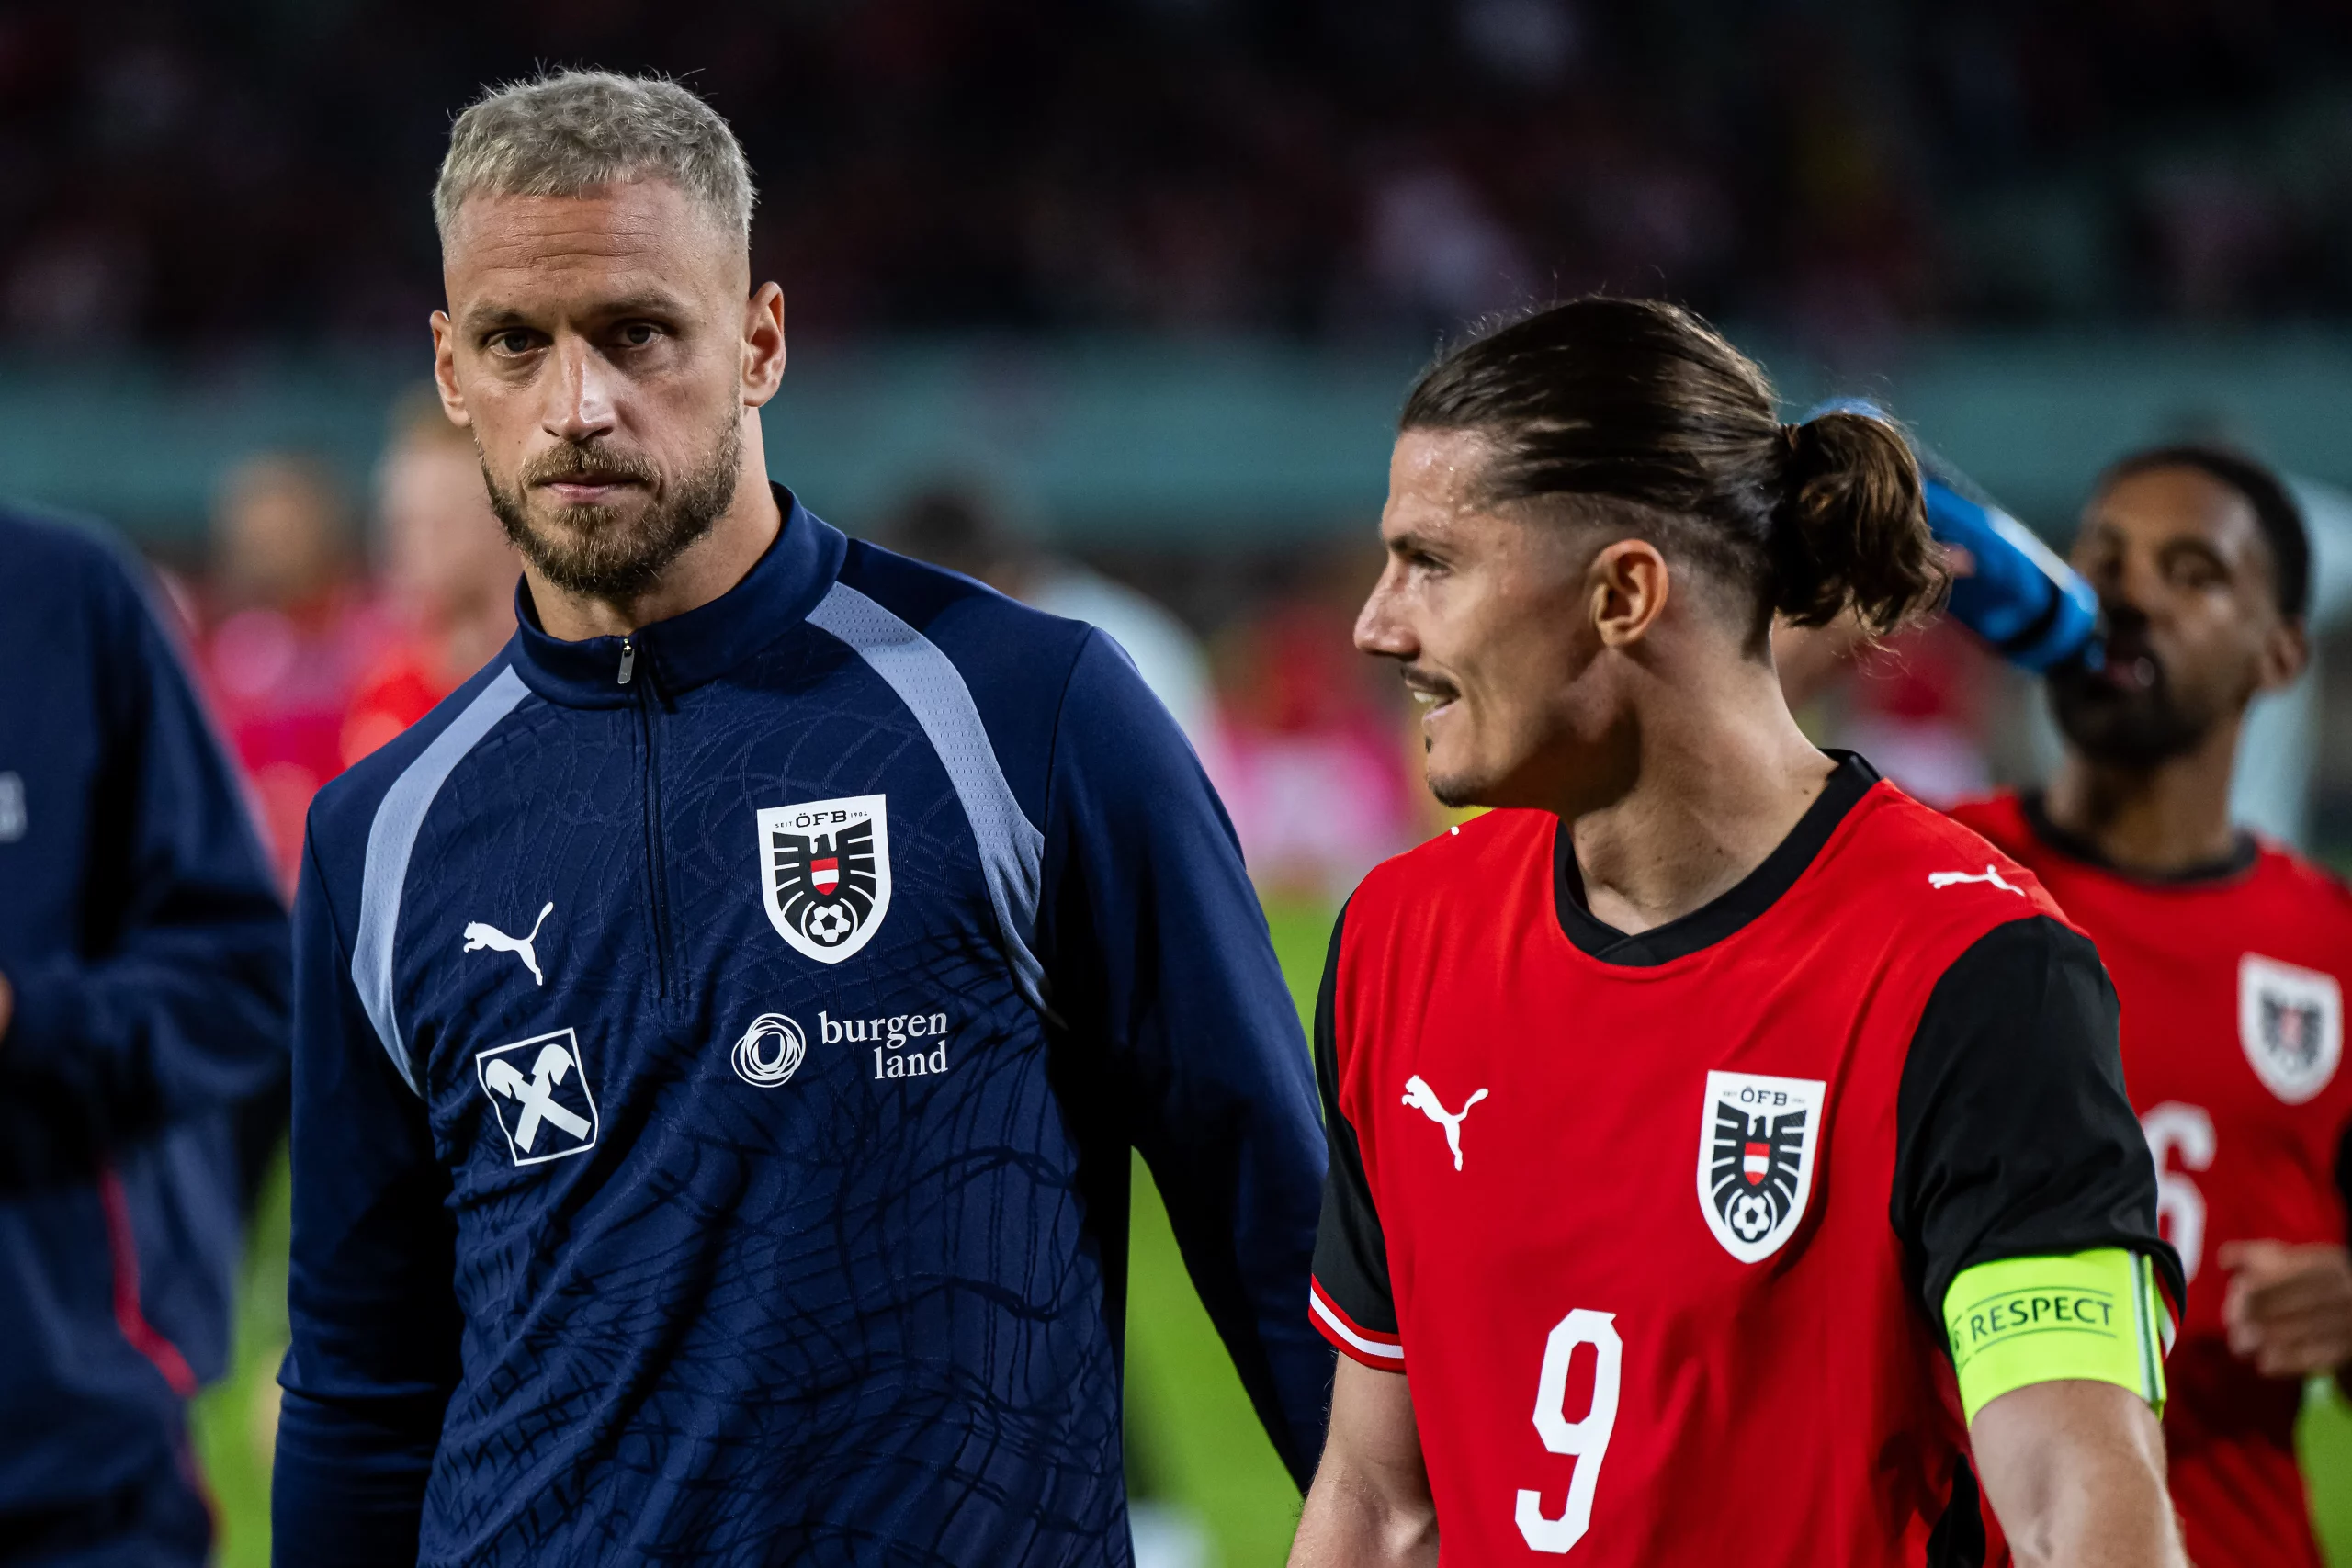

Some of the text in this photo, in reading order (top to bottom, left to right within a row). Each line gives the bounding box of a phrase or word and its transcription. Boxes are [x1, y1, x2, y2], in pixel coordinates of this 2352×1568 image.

[796, 810, 847, 828] ÖFB
[818, 1010, 949, 1050] burgen
[874, 1040, 949, 1080] land
[1741, 1086, 1788, 1106] ÖFB
[1970, 1296, 2114, 1342] RESPECT
[1514, 1307, 1623, 1554] 9
